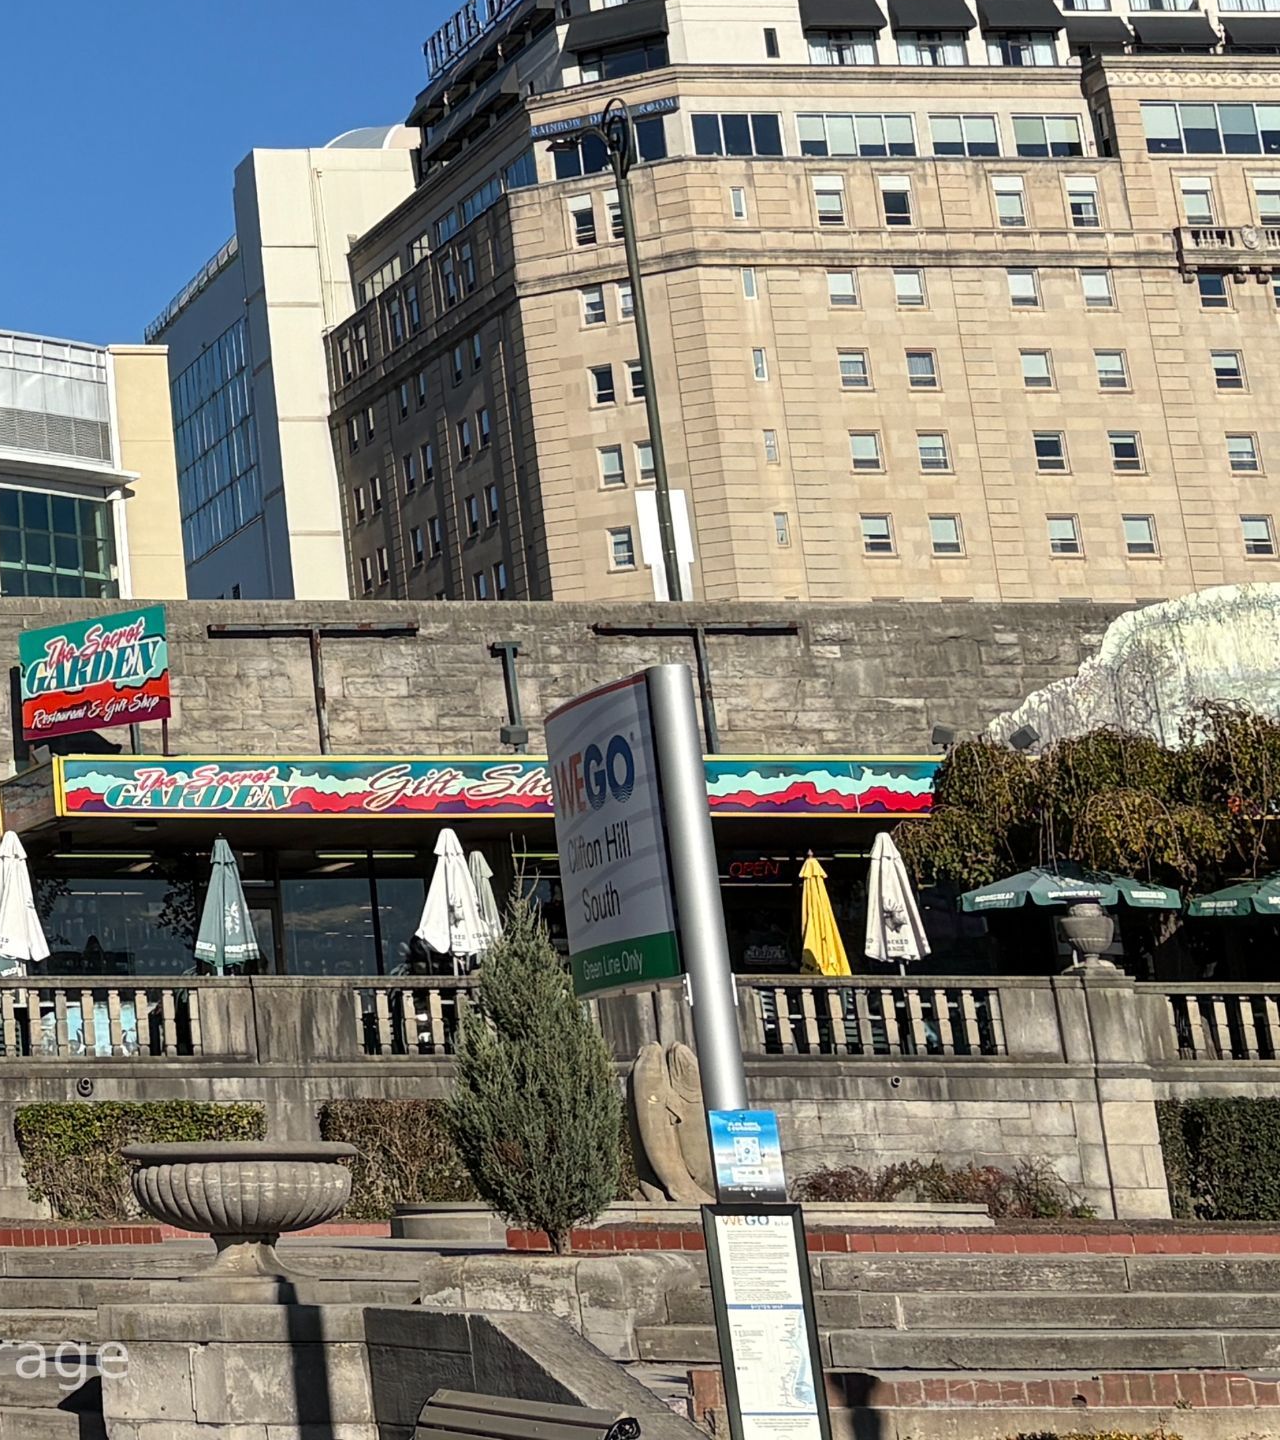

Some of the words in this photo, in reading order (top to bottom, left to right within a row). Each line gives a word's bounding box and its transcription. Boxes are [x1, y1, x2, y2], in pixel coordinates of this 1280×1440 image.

[531, 118, 581, 137] RAINBOW
[46, 636, 77, 670] The
[79, 617, 145, 660] Secret
[26, 639, 161, 695] GARDEN
[31, 705, 87, 730] Restaurant
[88, 700, 102, 717] &
[103, 696, 127, 722] Gift
[127, 693, 160, 713] Shop
[137, 768, 178, 791] The
[185, 765, 277, 791] Secret
[364, 764, 463, 810] Gift
[465, 763, 554, 806] Sho
[553, 734, 635, 818] WEGO
[105, 783, 297, 809] GARDEN
[568, 835, 603, 874] Clifton
[604, 820, 632, 862] Hill
[729, 861, 780, 877] OPEN
[582, 880, 621, 922] South
[603, 954, 621, 976] Line
[621, 949, 643, 975] Only
